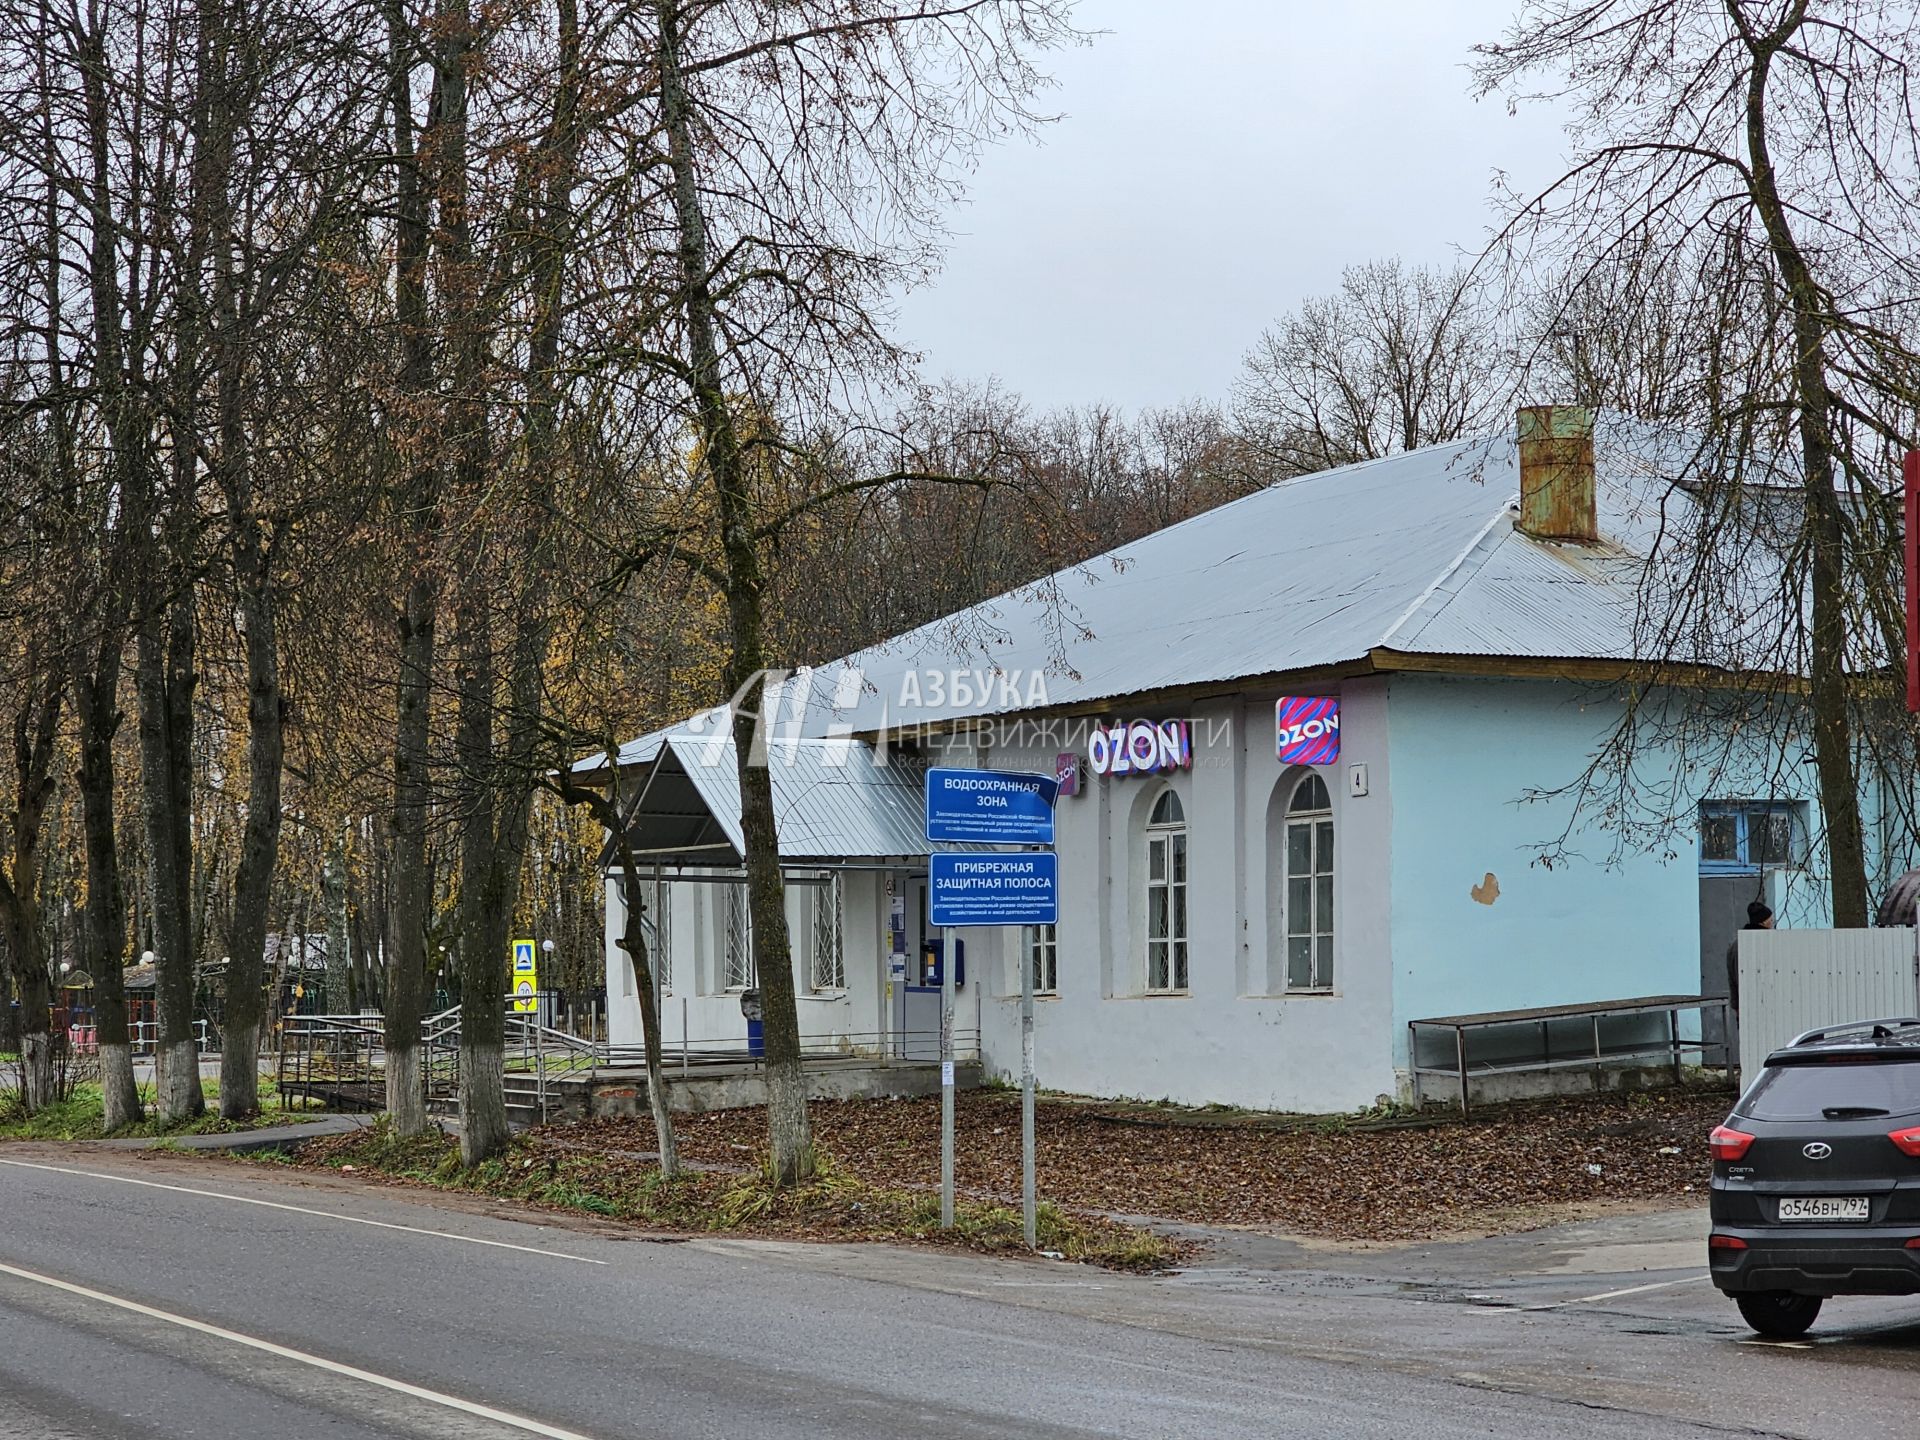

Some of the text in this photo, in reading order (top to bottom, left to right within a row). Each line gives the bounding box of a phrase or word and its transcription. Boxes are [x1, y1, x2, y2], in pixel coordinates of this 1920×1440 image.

[1088, 723, 1181, 774] OZON
[944, 778, 1041, 793] ВОДООХРАННАЯ
[1355, 772, 1361, 788] 4
[976, 795, 1008, 807] ЗОНА
[954, 862, 1034, 873] ПРИБРЕЖНАЯ
[936, 877, 1052, 891] ЗАЩИТНАЯ ПОЛОСА
[1784, 1198, 1865, 1216] О546ВН 797
